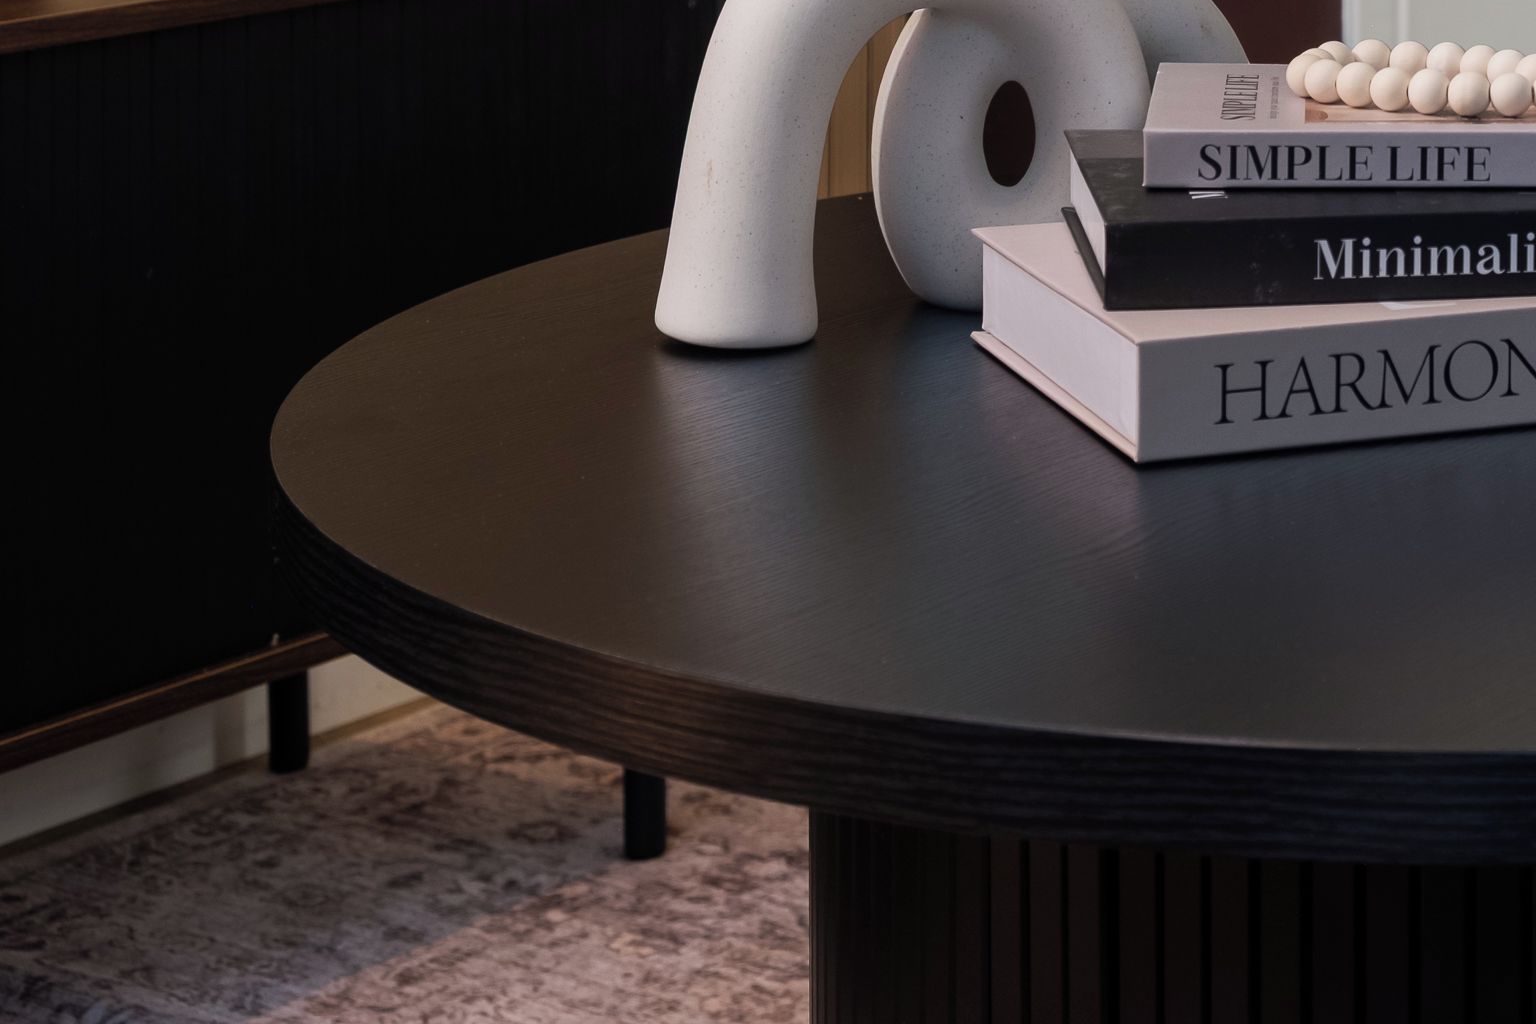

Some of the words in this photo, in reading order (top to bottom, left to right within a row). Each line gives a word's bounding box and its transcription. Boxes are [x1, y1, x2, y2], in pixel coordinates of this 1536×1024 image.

[1224, 74, 1259, 91] LIFE
[1220, 91, 1257, 121] SIMPLE
[1198, 144, 1374, 182] SIMPLE
[1387, 145, 1493, 182] LIFE
